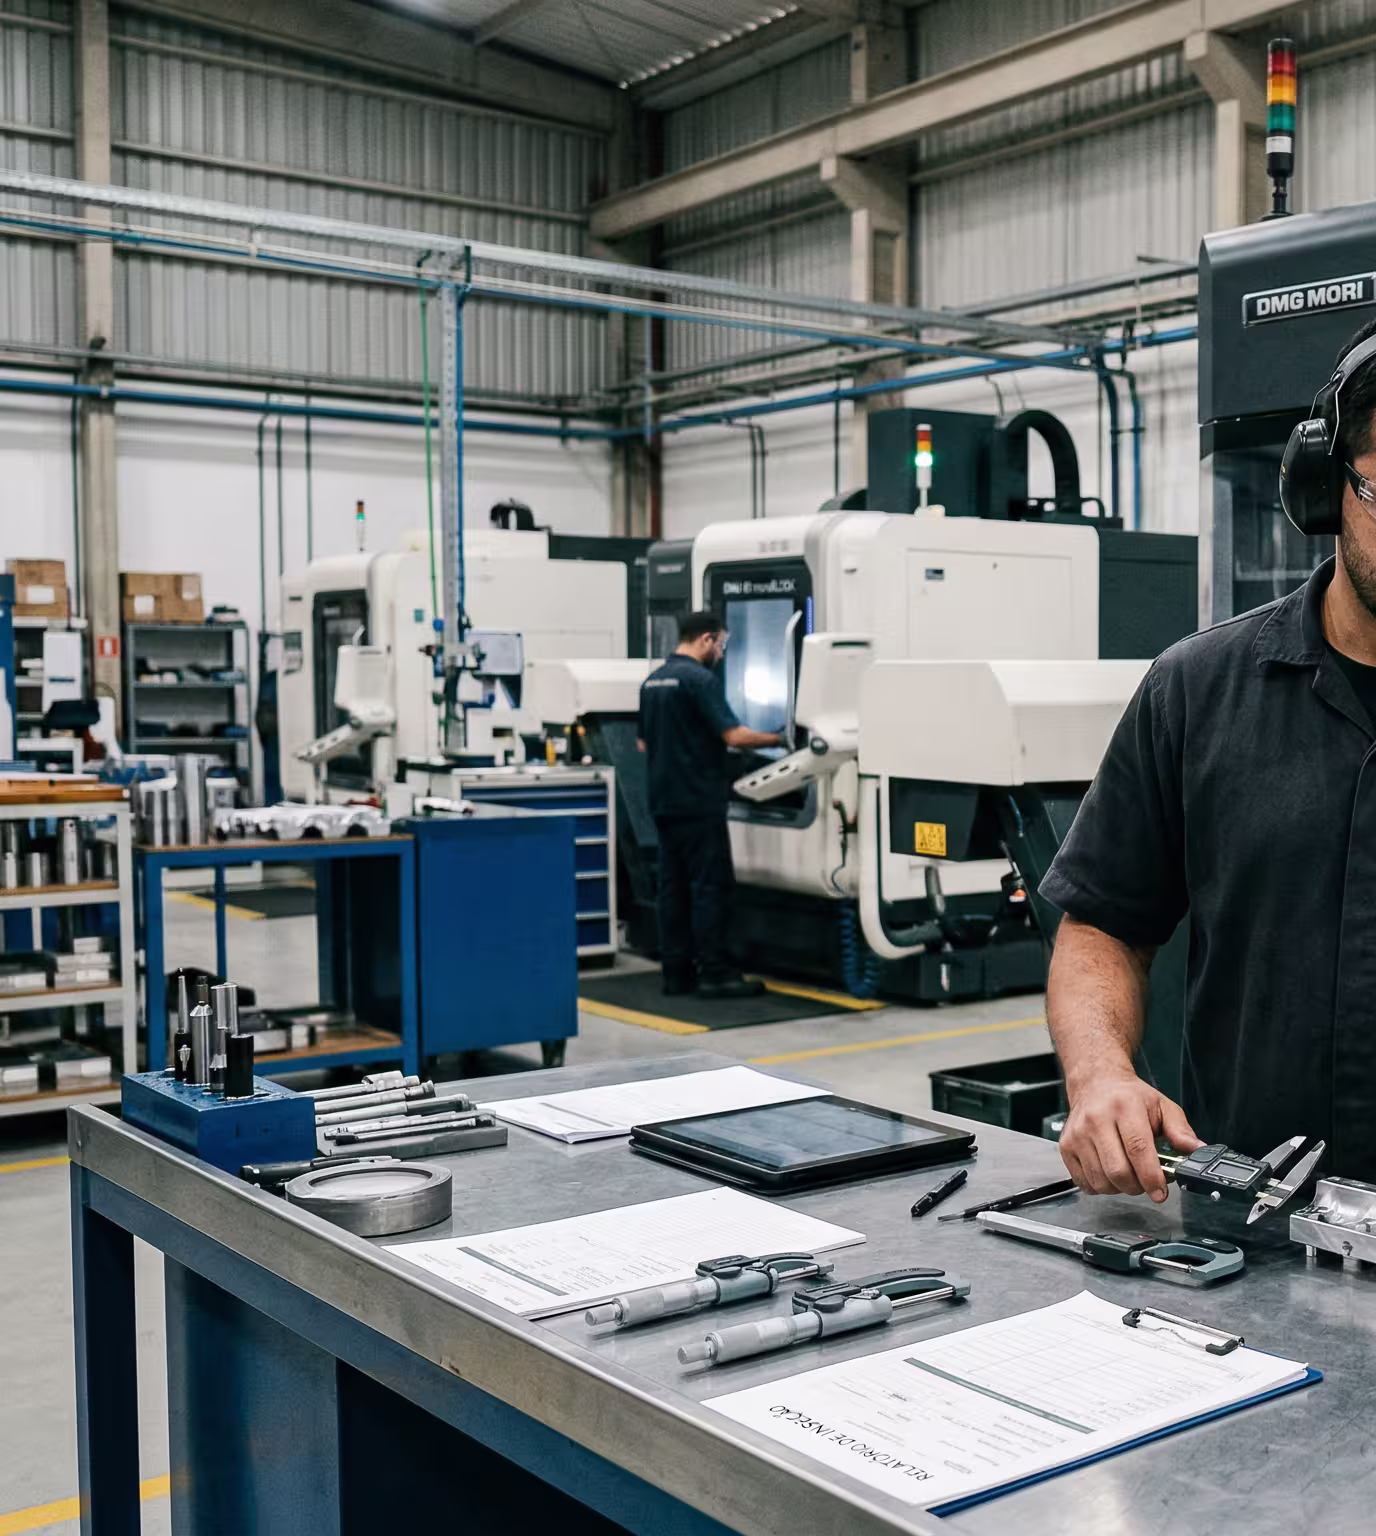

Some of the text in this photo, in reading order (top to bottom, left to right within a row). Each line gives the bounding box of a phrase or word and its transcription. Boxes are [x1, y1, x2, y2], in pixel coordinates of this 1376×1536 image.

[1256, 280, 1364, 316] DMG MORI
[827, 1432, 857, 1447] DE
